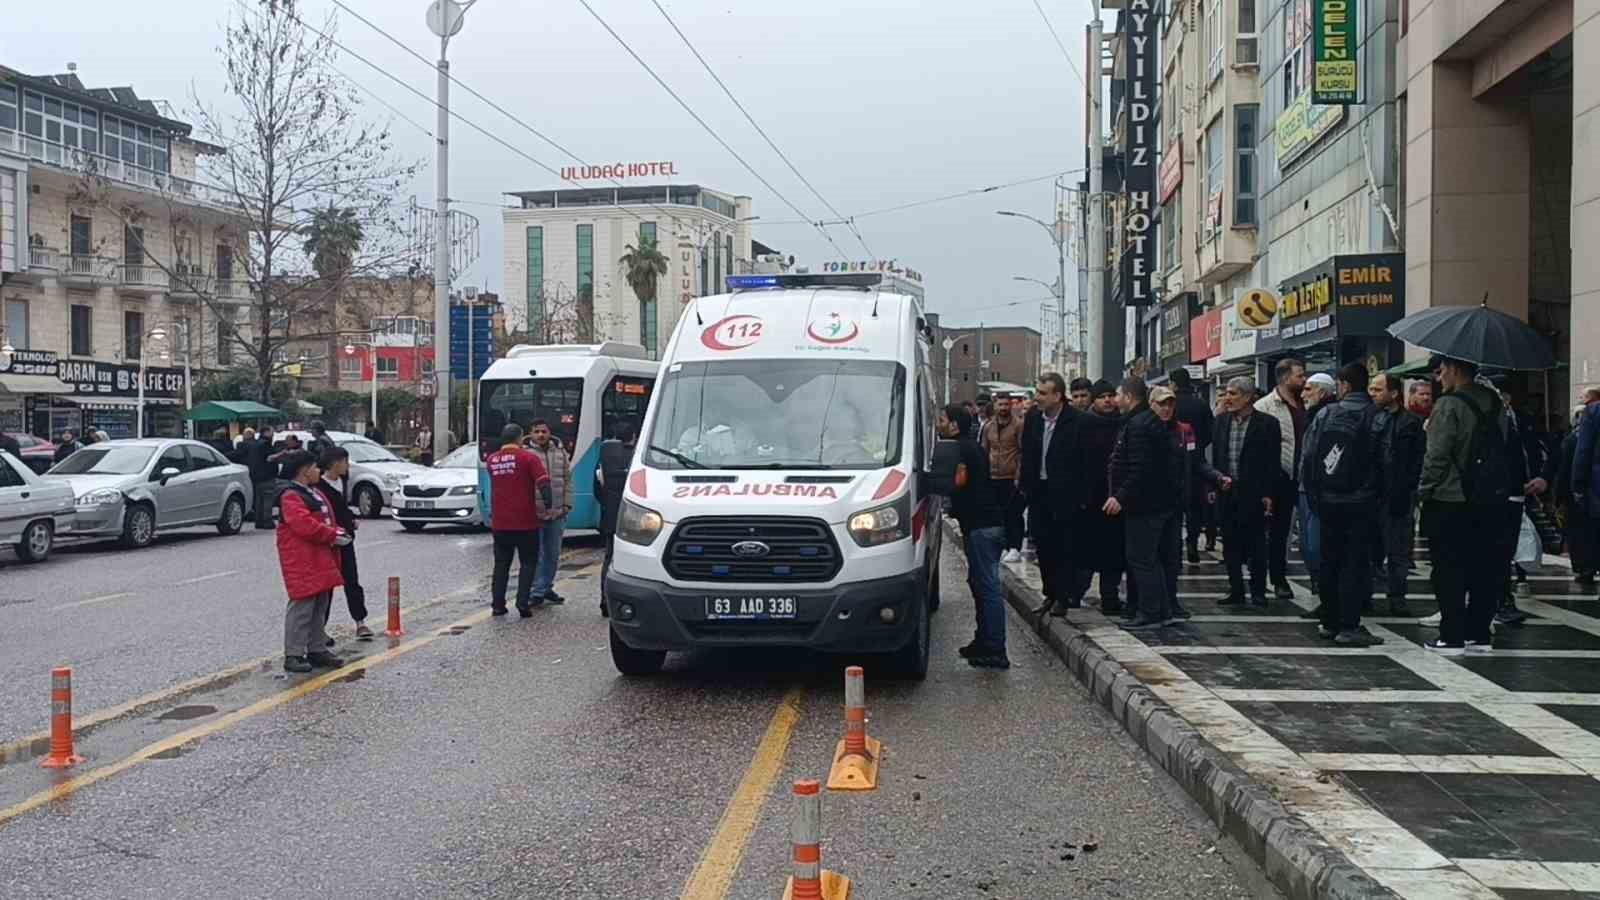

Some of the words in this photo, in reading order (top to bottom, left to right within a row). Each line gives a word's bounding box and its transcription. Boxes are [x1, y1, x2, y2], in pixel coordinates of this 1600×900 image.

[1320, 79, 1351, 90] KURSU
[561, 163, 624, 180] ULUDAĞ
[628, 161, 679, 177] HOTEL
[1128, 191, 1150, 299] HOTEL
[1339, 264, 1392, 284] EMİR
[1339, 292, 1393, 306] İLETİŞİM
[727, 322, 762, 339] 112
[59, 362, 96, 382] BARAN
[165, 374, 183, 391] CEP
[714, 599, 731, 614] 63
[740, 599, 764, 614] AAD
[768, 599, 793, 614] 336
